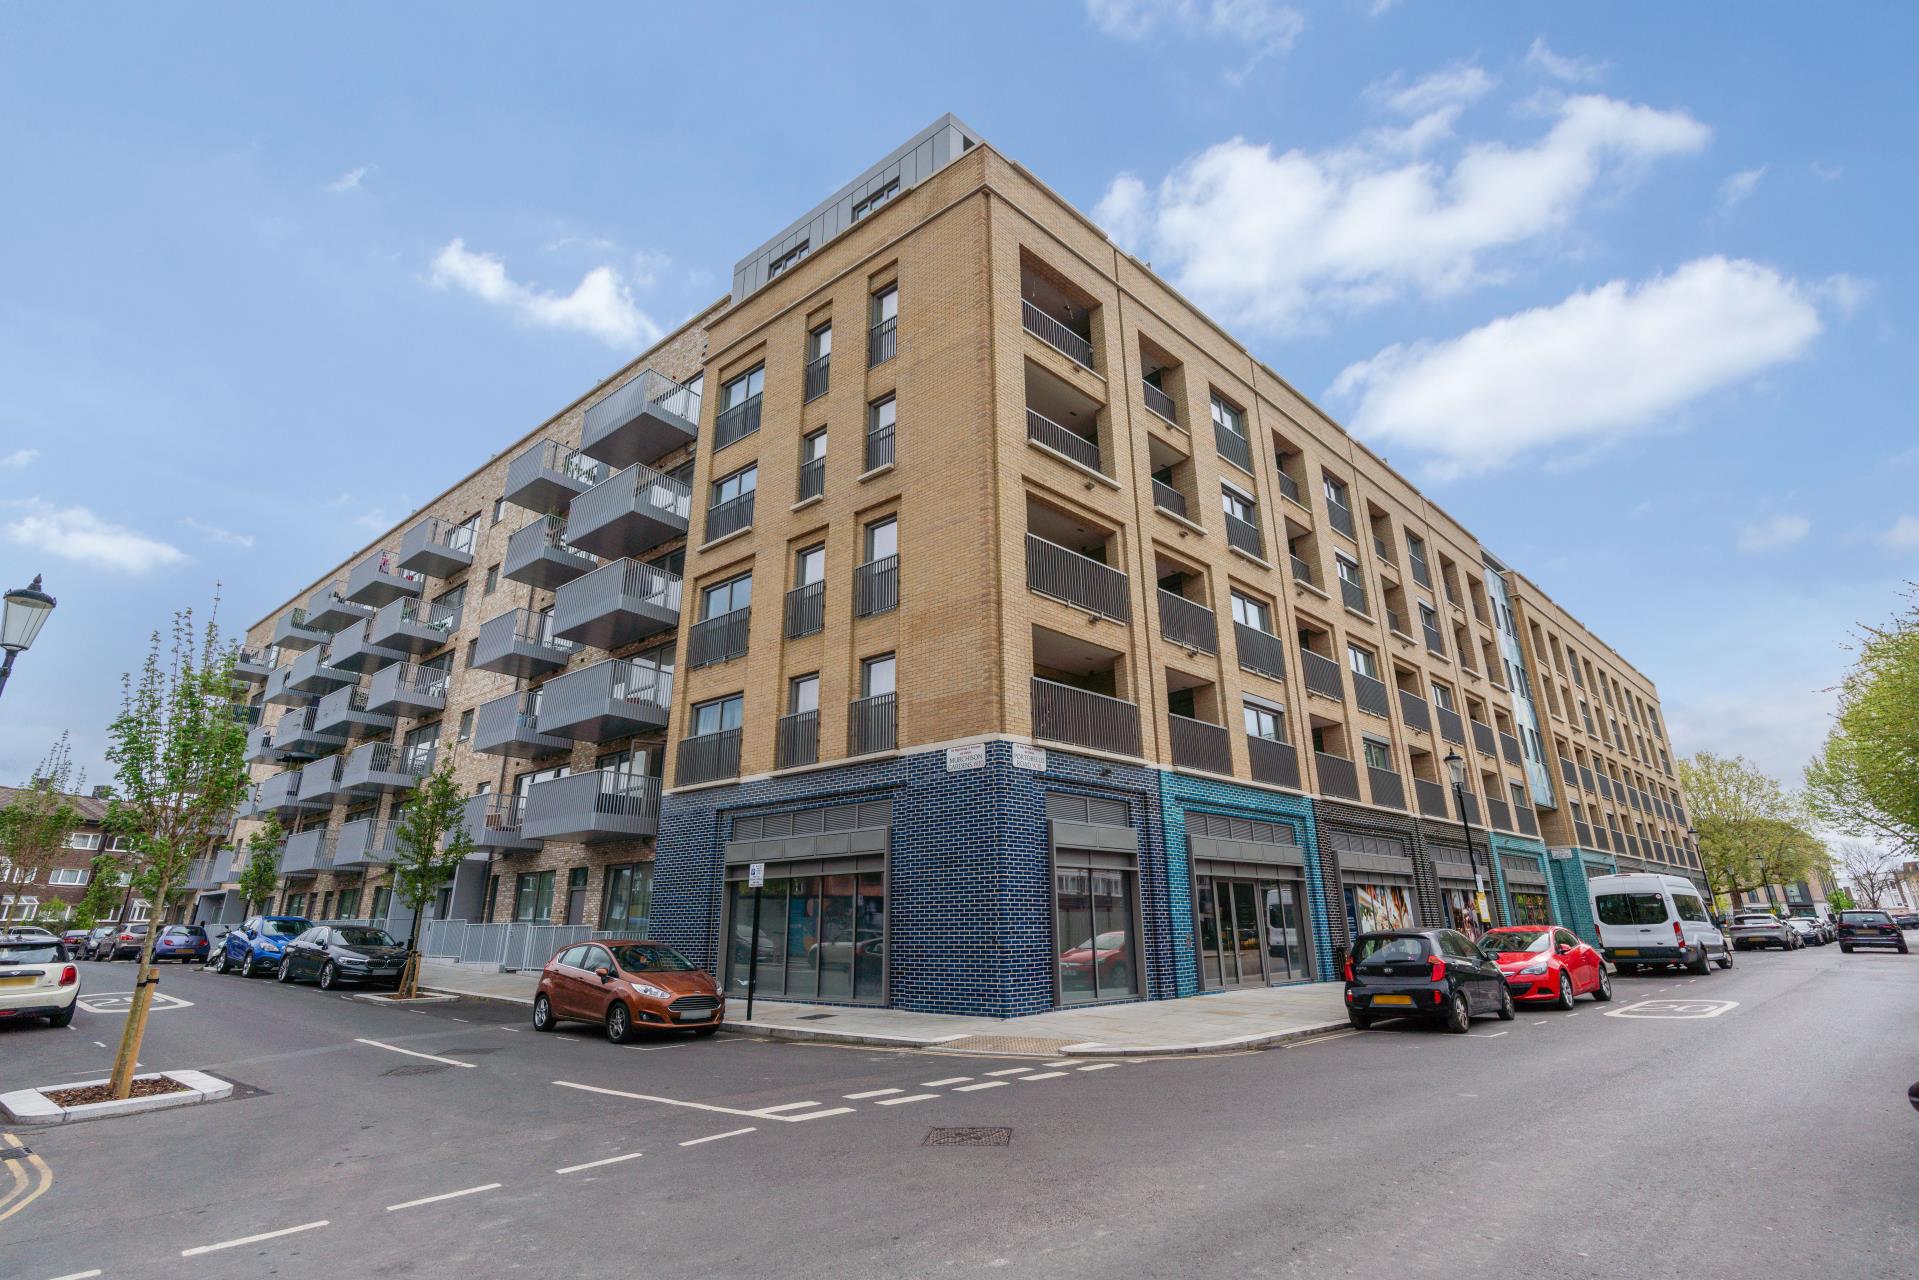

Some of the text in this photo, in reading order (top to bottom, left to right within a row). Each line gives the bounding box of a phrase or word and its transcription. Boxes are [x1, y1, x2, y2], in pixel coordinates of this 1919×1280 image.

[950, 753, 983, 763] MURCHISON
[1014, 753, 1044, 763] PORTOBELLO
[948, 762, 972, 770] GARDENS
[1017, 760, 1033, 768] ROAD
[1631, 1004, 1719, 1012] 20
